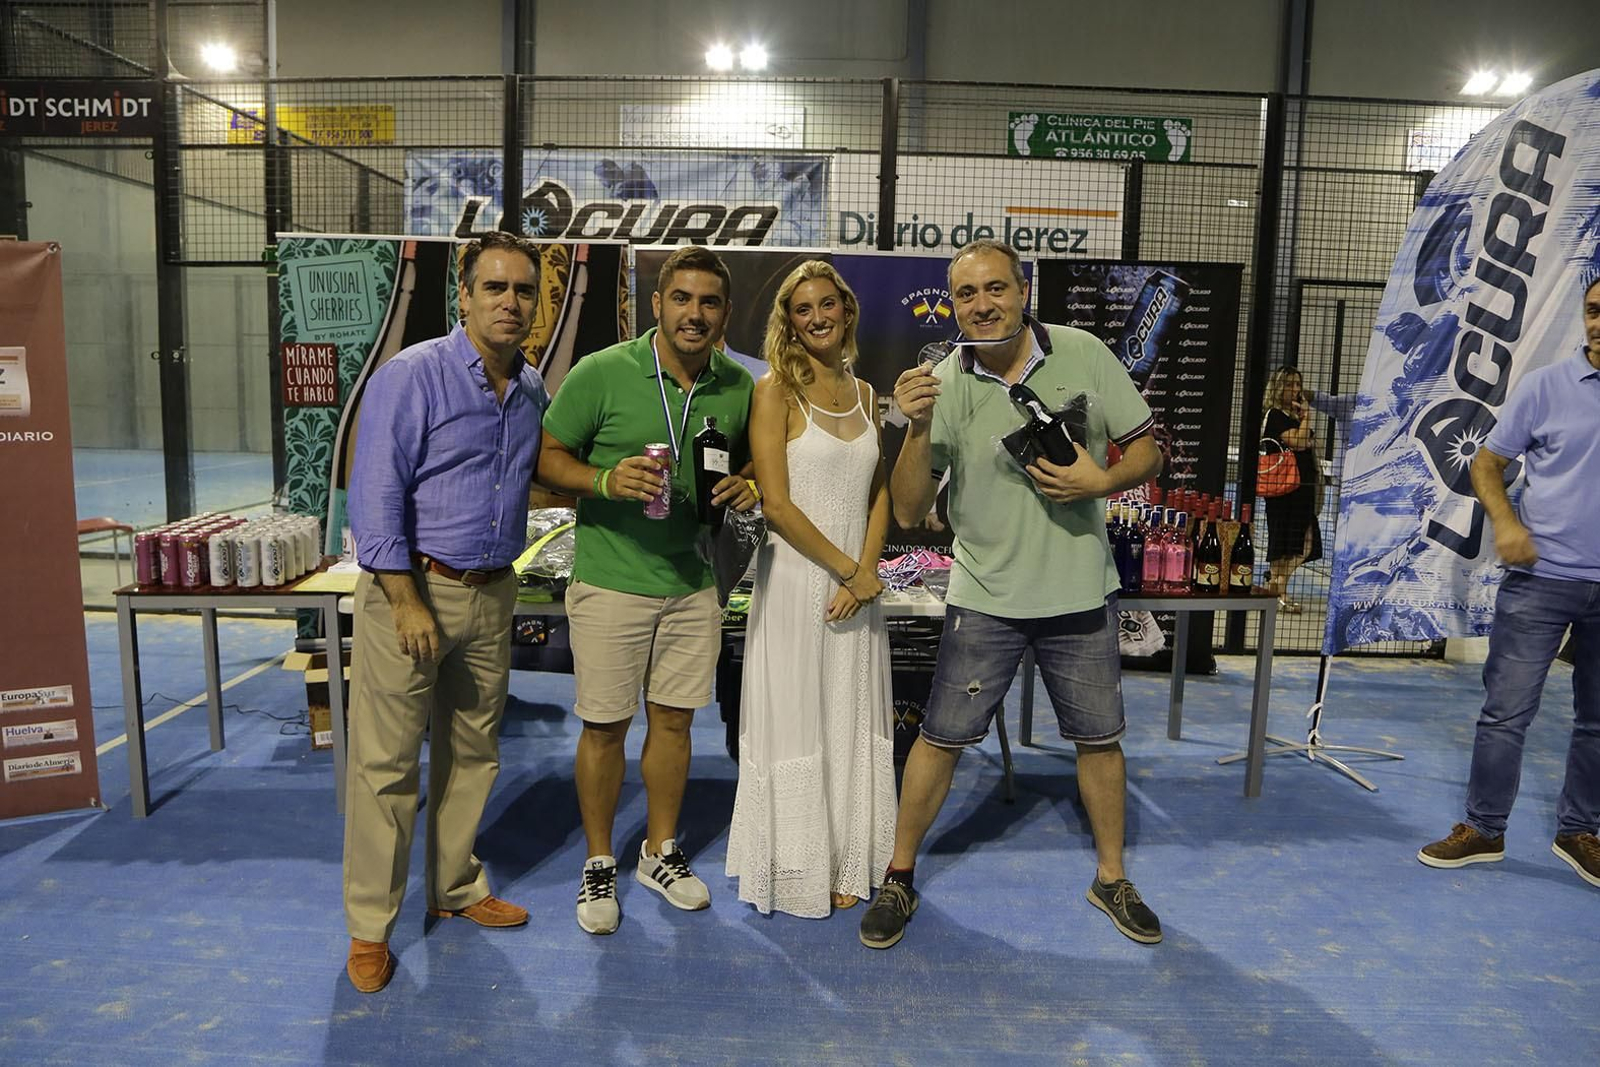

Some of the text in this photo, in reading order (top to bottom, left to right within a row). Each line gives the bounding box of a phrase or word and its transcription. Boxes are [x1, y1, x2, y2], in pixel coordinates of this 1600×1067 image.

[81, 121, 118, 134] JEREZ
[1104, 118, 1131, 129] DEL
[1133, 118, 1155, 130] PIE
[1045, 128, 1157, 147] ATLÁNTICO
[1071, 147, 1093, 158] 956
[1096, 148, 1110, 159] 30
[455, 181, 779, 246] LOCURA
[839, 211, 942, 248] Dirio
[950, 212, 995, 249] de
[308, 270, 362, 295] UNUSUAL
[310, 298, 363, 321] SHERRIES
[314, 333, 326, 341] BY
[1122, 286, 1169, 373] LOCURA
[1415, 119, 1568, 560] LOCURA
[286, 367, 334, 385] CUANDO
[287, 386, 334, 402] TE HABLO
[5, 725, 43, 737] Huelva
